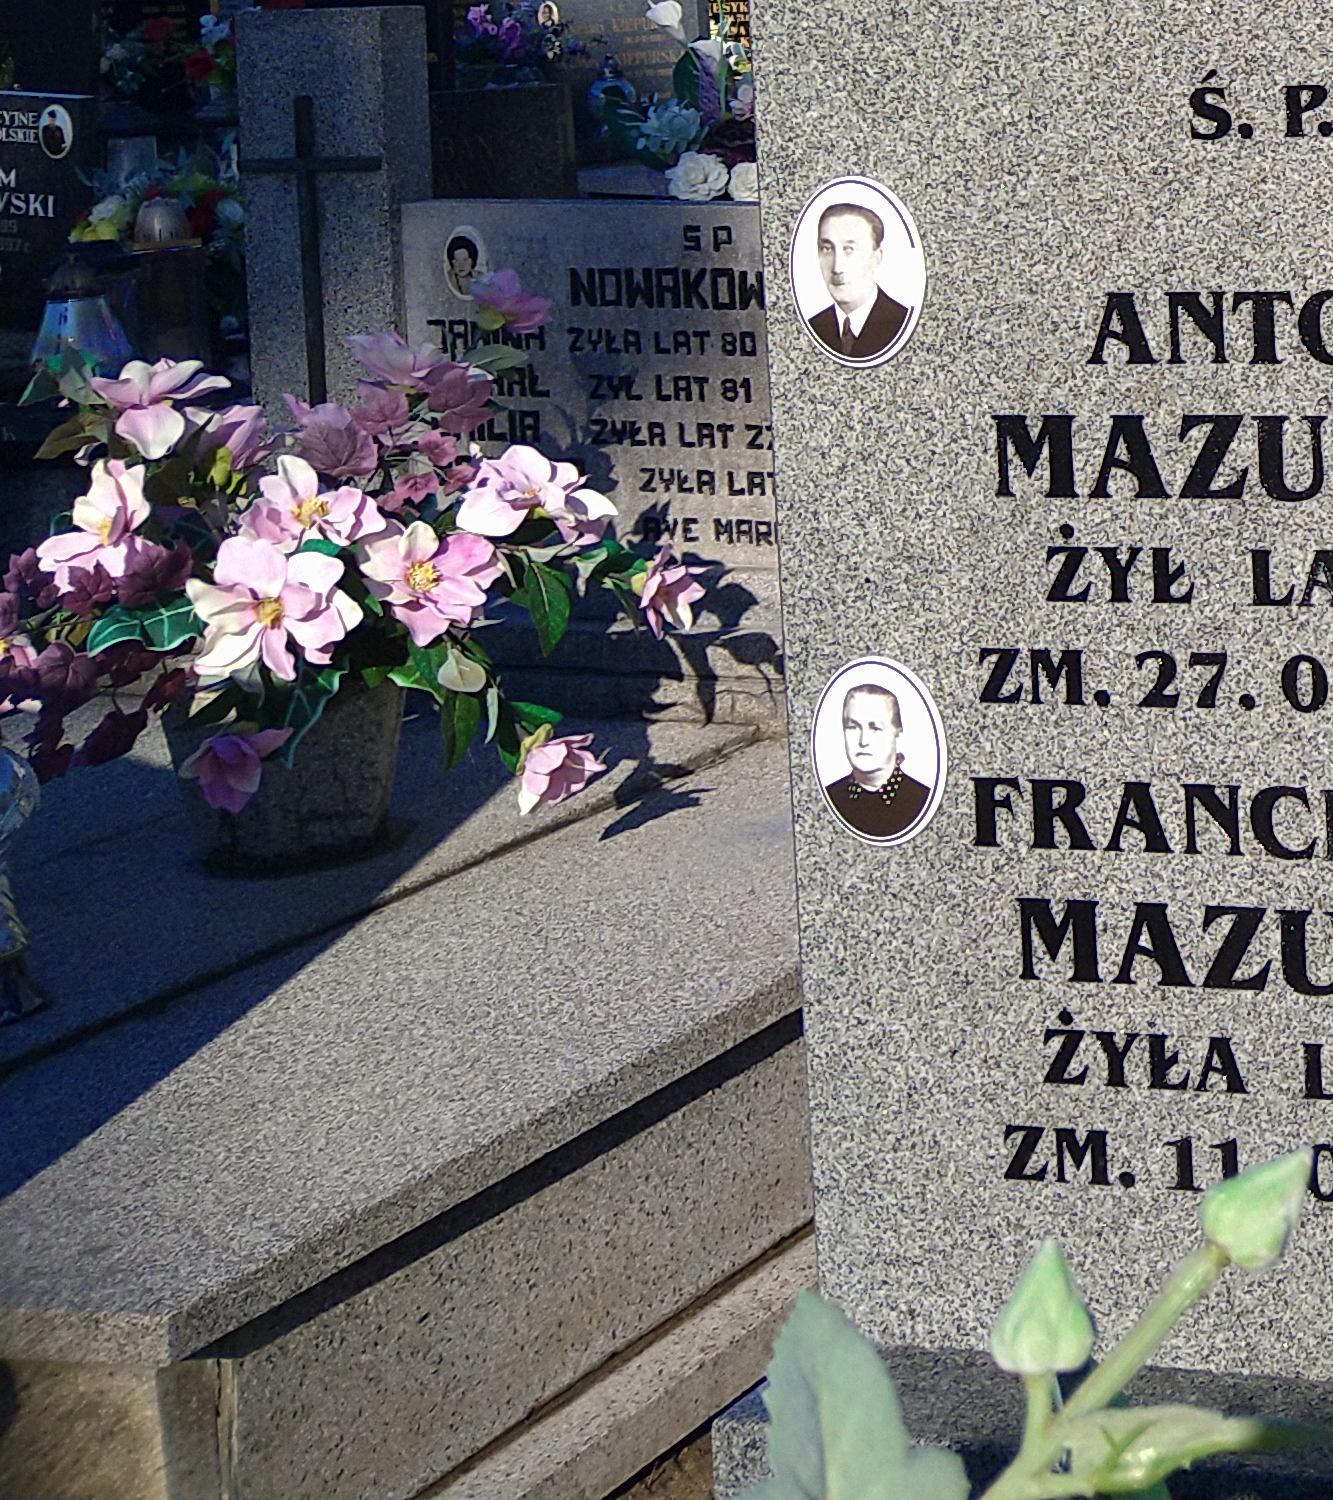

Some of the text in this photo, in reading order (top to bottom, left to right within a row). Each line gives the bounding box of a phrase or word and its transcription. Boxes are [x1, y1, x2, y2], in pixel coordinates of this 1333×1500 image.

[0, 111, 39, 128] YJNE
[0, 128, 39, 144] LSKIE
[654, 331, 710, 356] LAT
[655, 374, 709, 403] LAT
[678, 421, 734, 449] LAT
[1045, 523, 1195, 603] ŻYŁ
[1043, 1008, 1249, 1094] ŻYŁA
